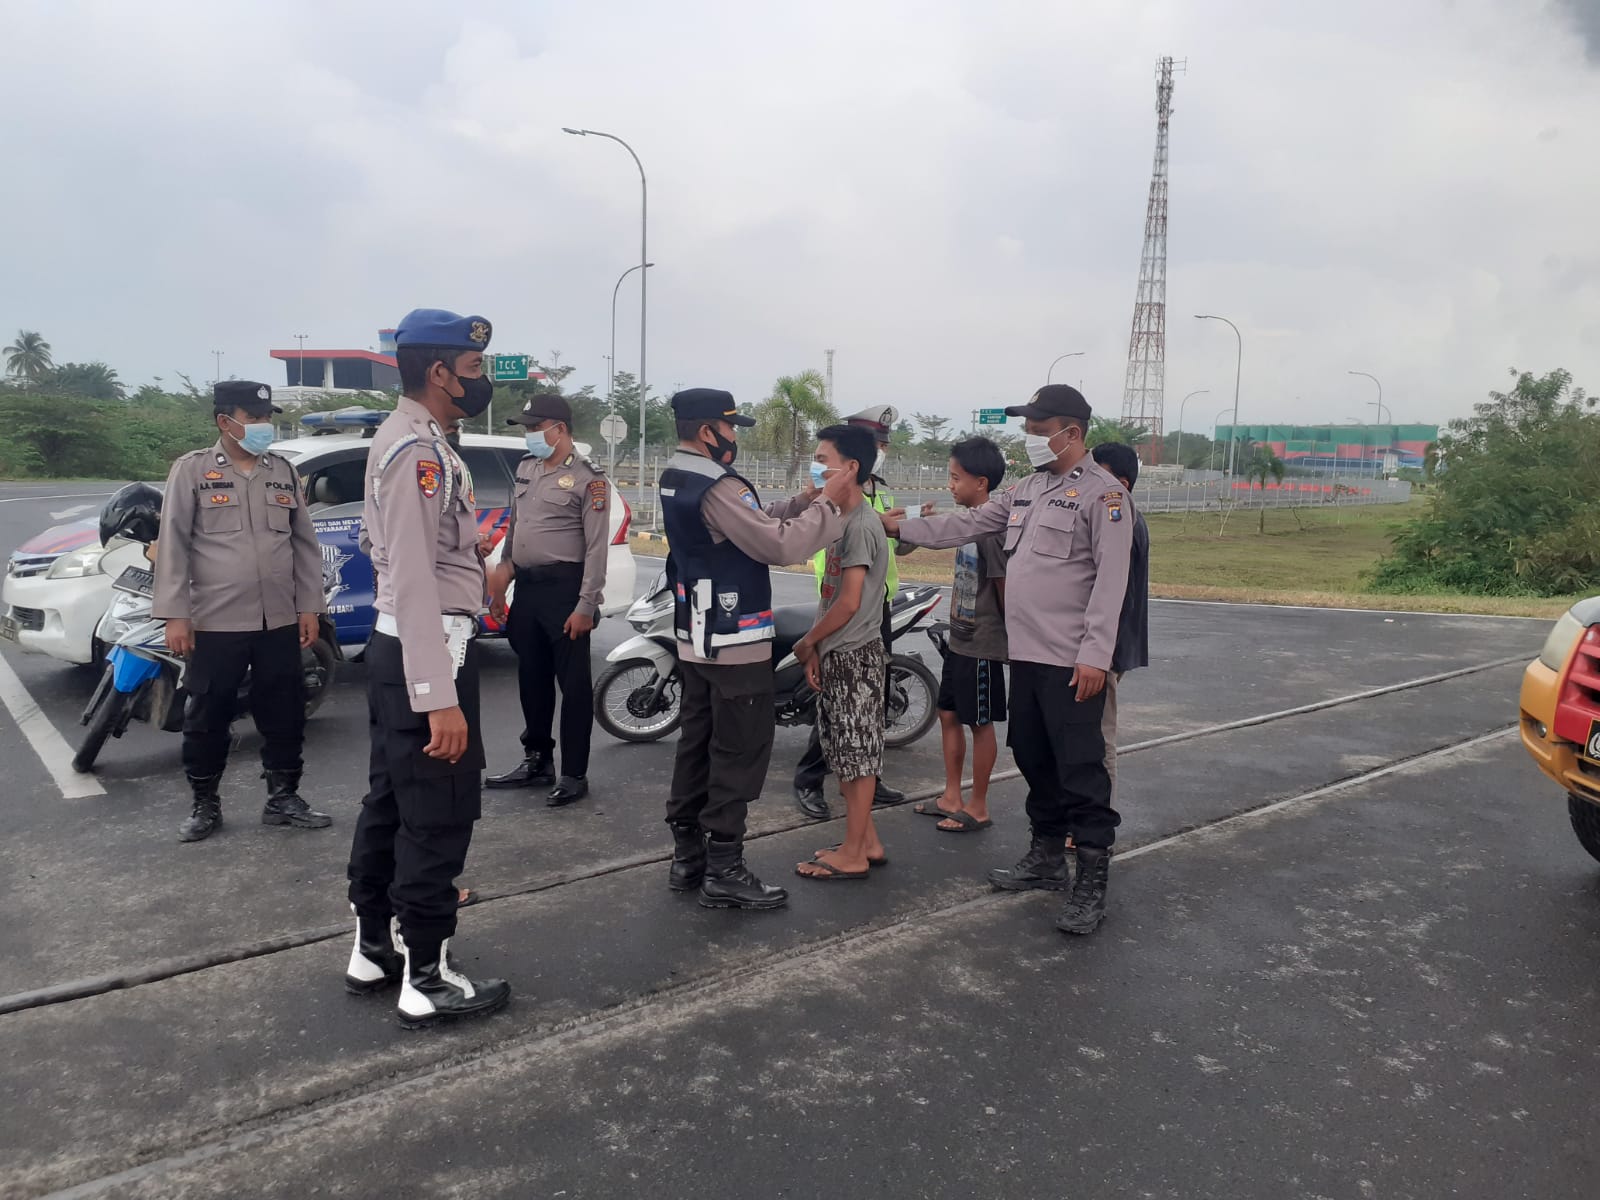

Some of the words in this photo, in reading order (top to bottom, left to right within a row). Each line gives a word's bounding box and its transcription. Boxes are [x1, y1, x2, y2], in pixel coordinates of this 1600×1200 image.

[498, 360, 517, 370] TCC
[265, 482, 293, 491] POLRI
[1047, 499, 1080, 511] POLRI
